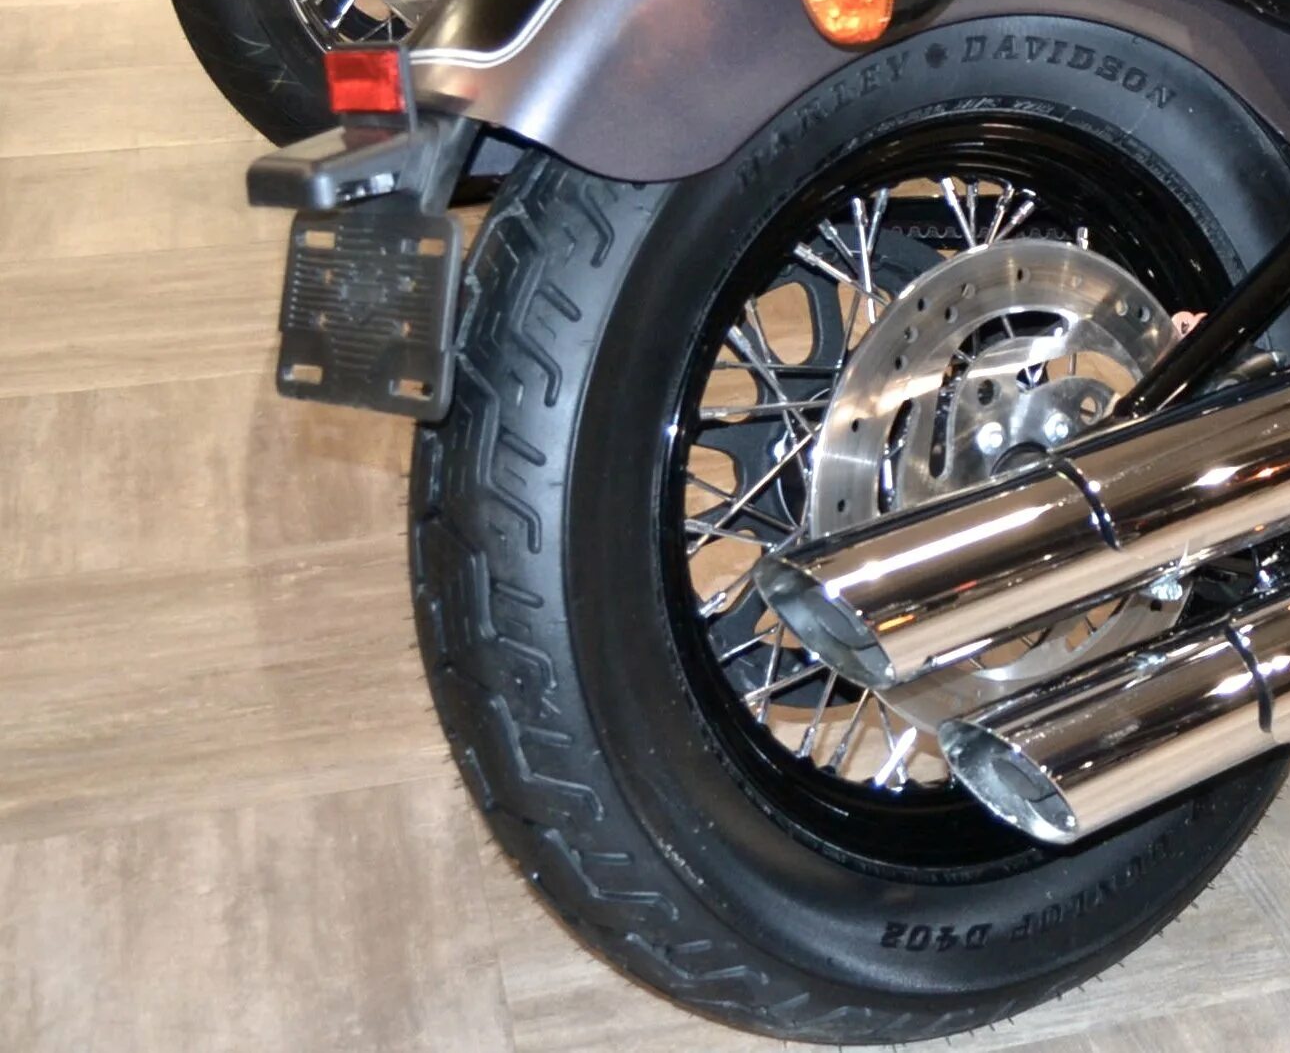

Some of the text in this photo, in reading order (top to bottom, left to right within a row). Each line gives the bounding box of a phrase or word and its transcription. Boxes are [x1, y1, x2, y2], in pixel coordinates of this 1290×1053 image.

[734, 34, 1177, 193] HARLEY DAVIDSON
[880, 921, 993, 951] D402
